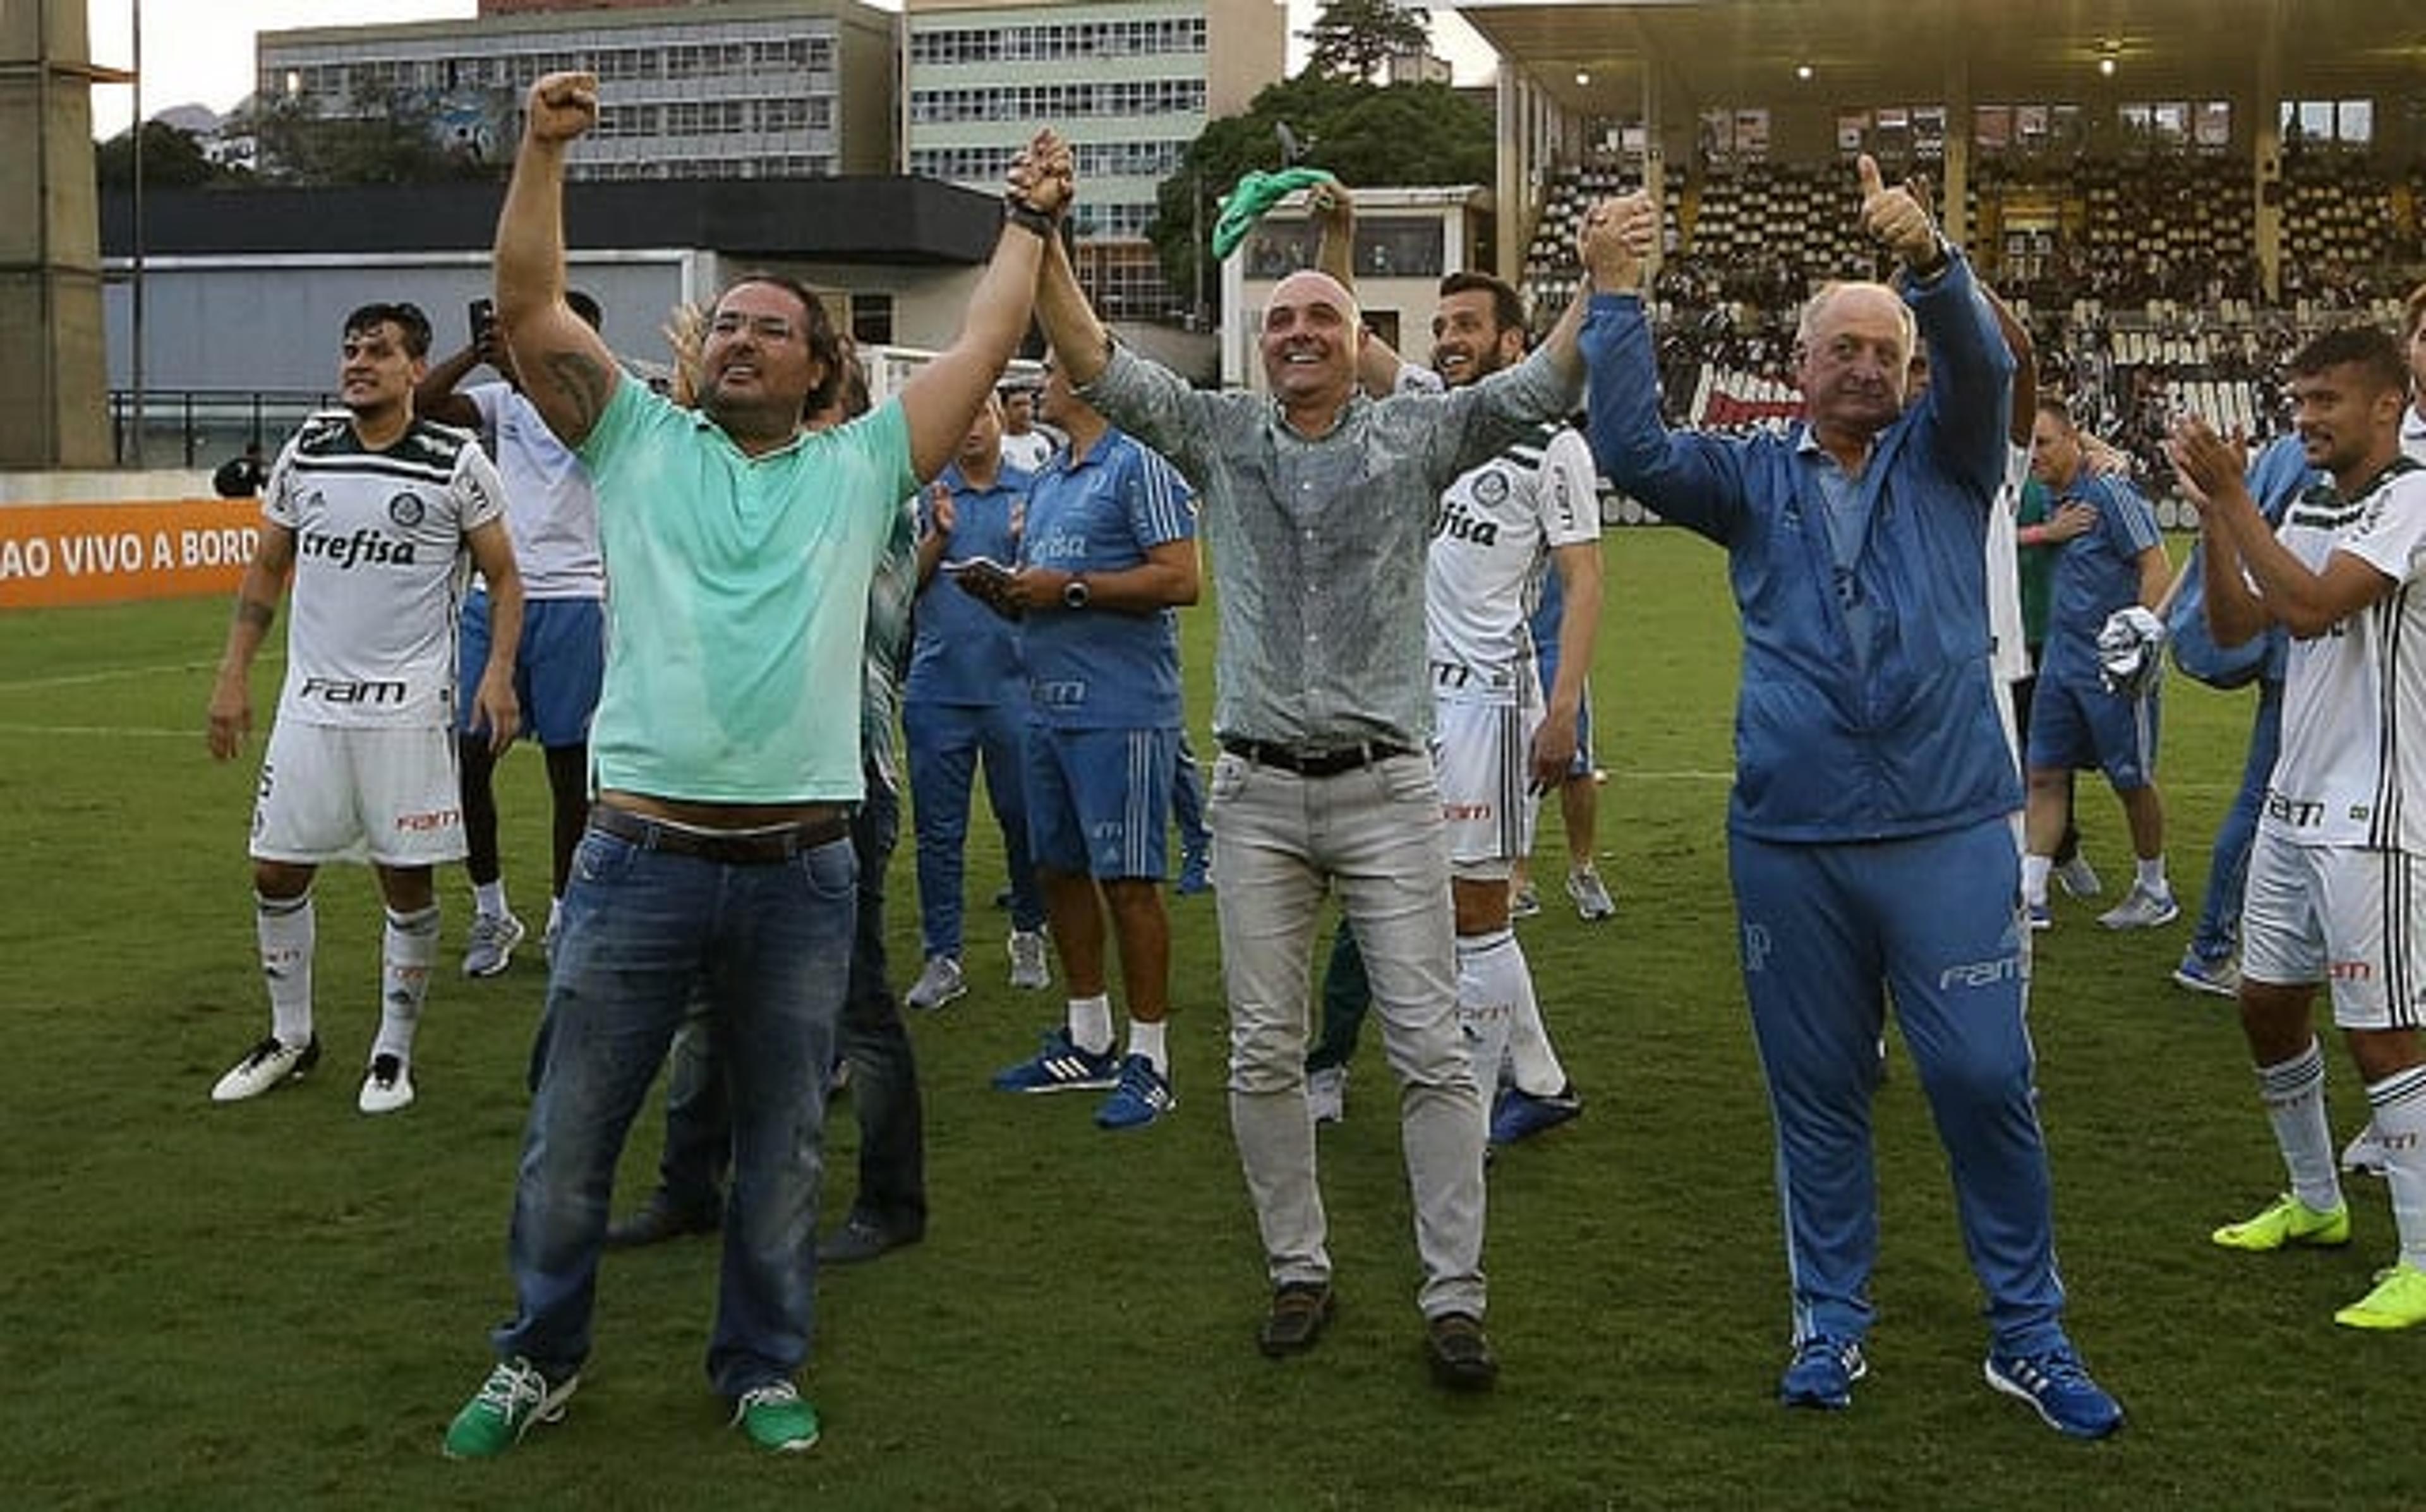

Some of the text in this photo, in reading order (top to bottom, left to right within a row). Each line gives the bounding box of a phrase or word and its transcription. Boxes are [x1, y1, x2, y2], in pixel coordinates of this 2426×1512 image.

[1, 537, 51, 579] AO
[60, 532, 142, 575] VIVO
[152, 531, 175, 569] A
